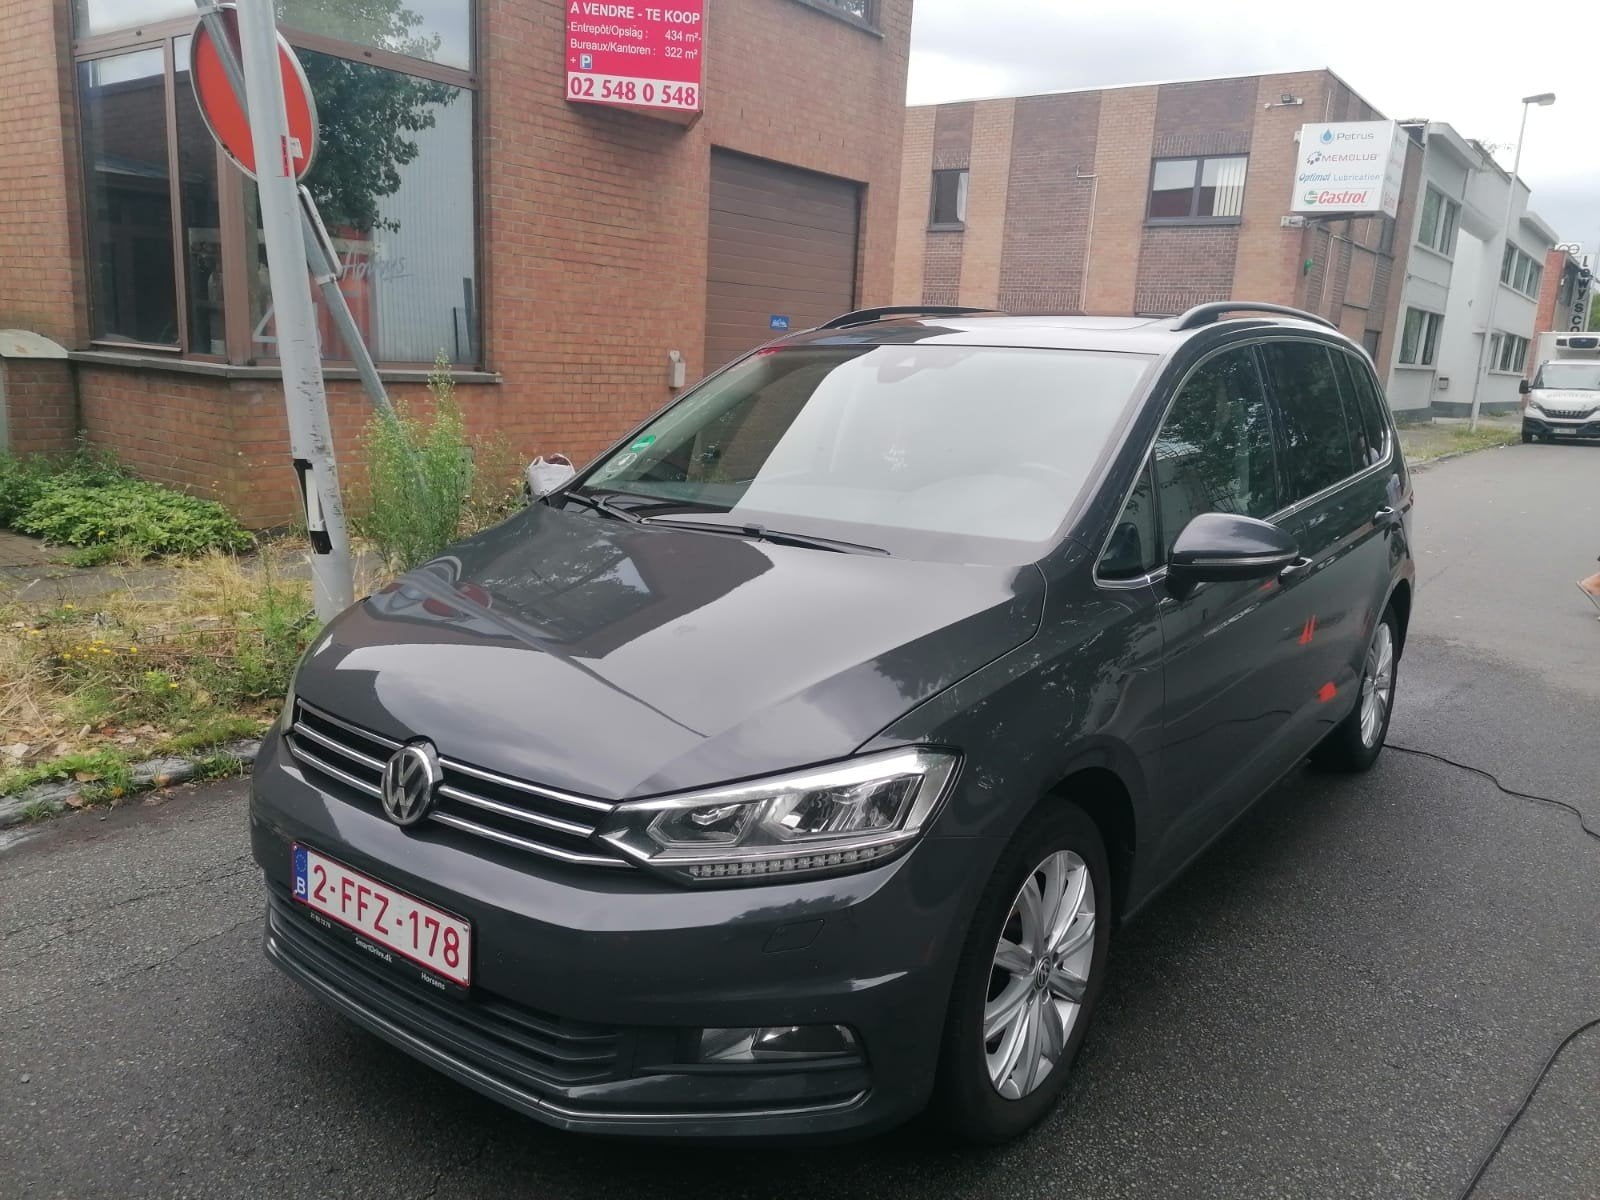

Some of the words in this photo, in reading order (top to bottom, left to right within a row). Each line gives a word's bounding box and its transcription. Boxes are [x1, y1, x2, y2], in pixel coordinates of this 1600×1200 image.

[570, 1, 580, 14] A
[583, 2, 635, 19] VENDRE
[645, 8, 661, 21] TE
[664, 9, 700, 24] KOOP
[664, 29, 683, 42] 434
[570, 38, 651, 56] Bureaux/Kantoren
[664, 46, 683, 58] 322
[685, 49, 698, 60] m²
[570, 76, 594, 97] 02
[601, 79, 636, 101] 548
[642, 83, 655, 102] 0
[661, 85, 696, 106] 548
[1336, 132, 1375, 141] Petrus
[1321, 153, 1377, 162] MEMOLUB
[1299, 172, 1331, 184] Optimal
[1333, 173, 1380, 182] Lubrication
[1318, 190, 1368, 205] Castrol
[296, 876, 306, 895] B
[421, 971, 446, 990] Horsens
